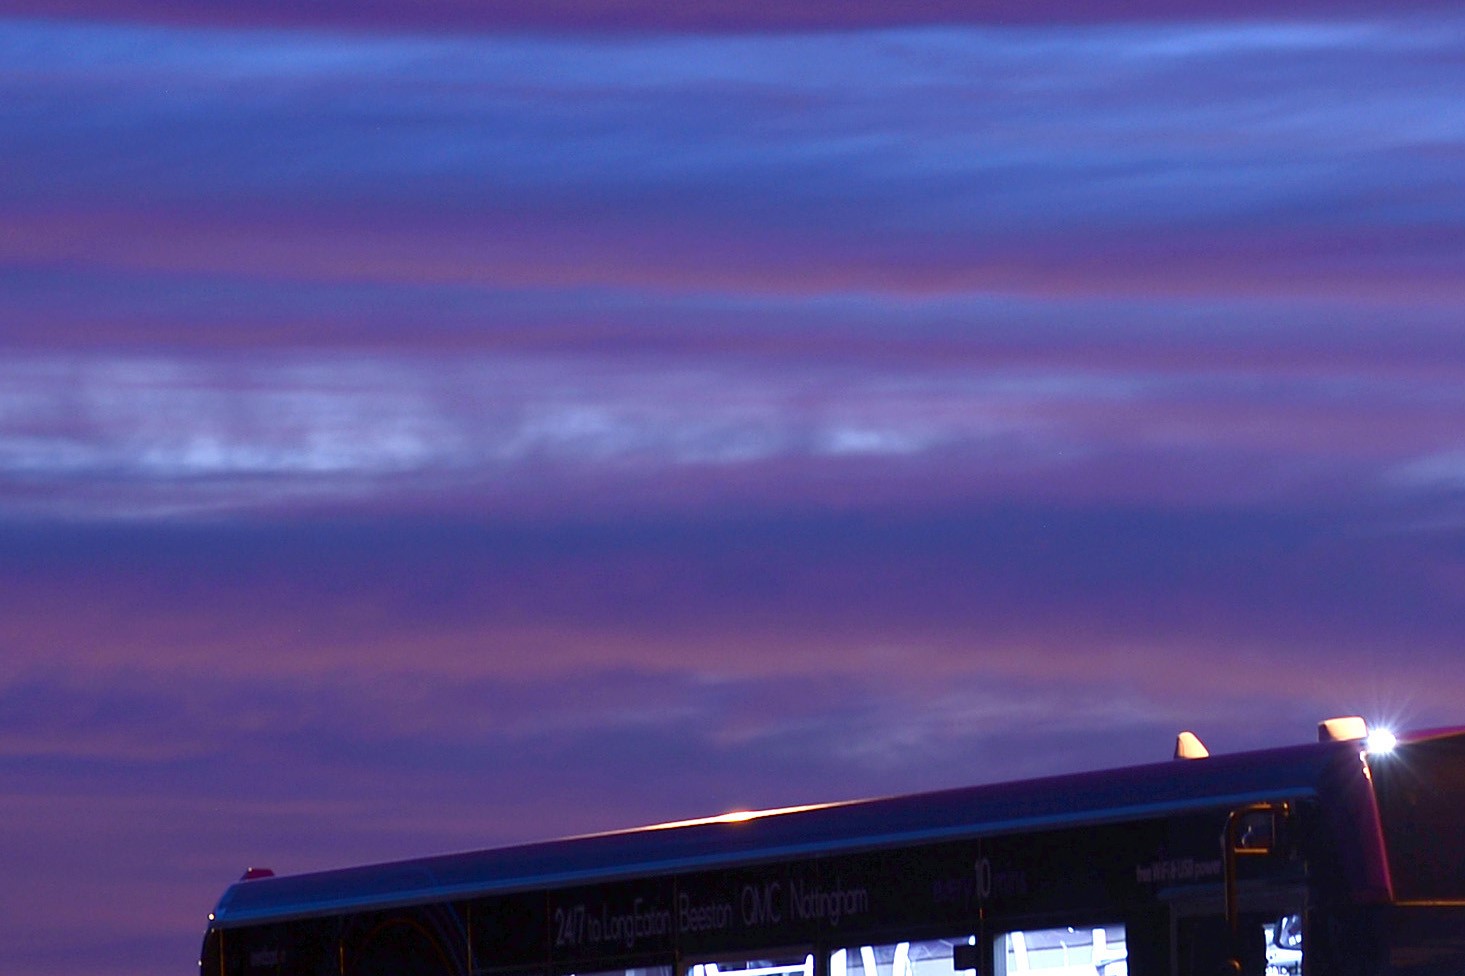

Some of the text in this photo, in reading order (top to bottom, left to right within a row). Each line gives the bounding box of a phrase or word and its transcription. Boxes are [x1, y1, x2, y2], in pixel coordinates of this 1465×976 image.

[602, 902, 634, 947] Long
[634, 897, 672, 938] Eaton
[678, 892, 732, 932] Beeston
[741, 881, 781, 926] QMC
[789, 875, 869, 926] Nottingham
